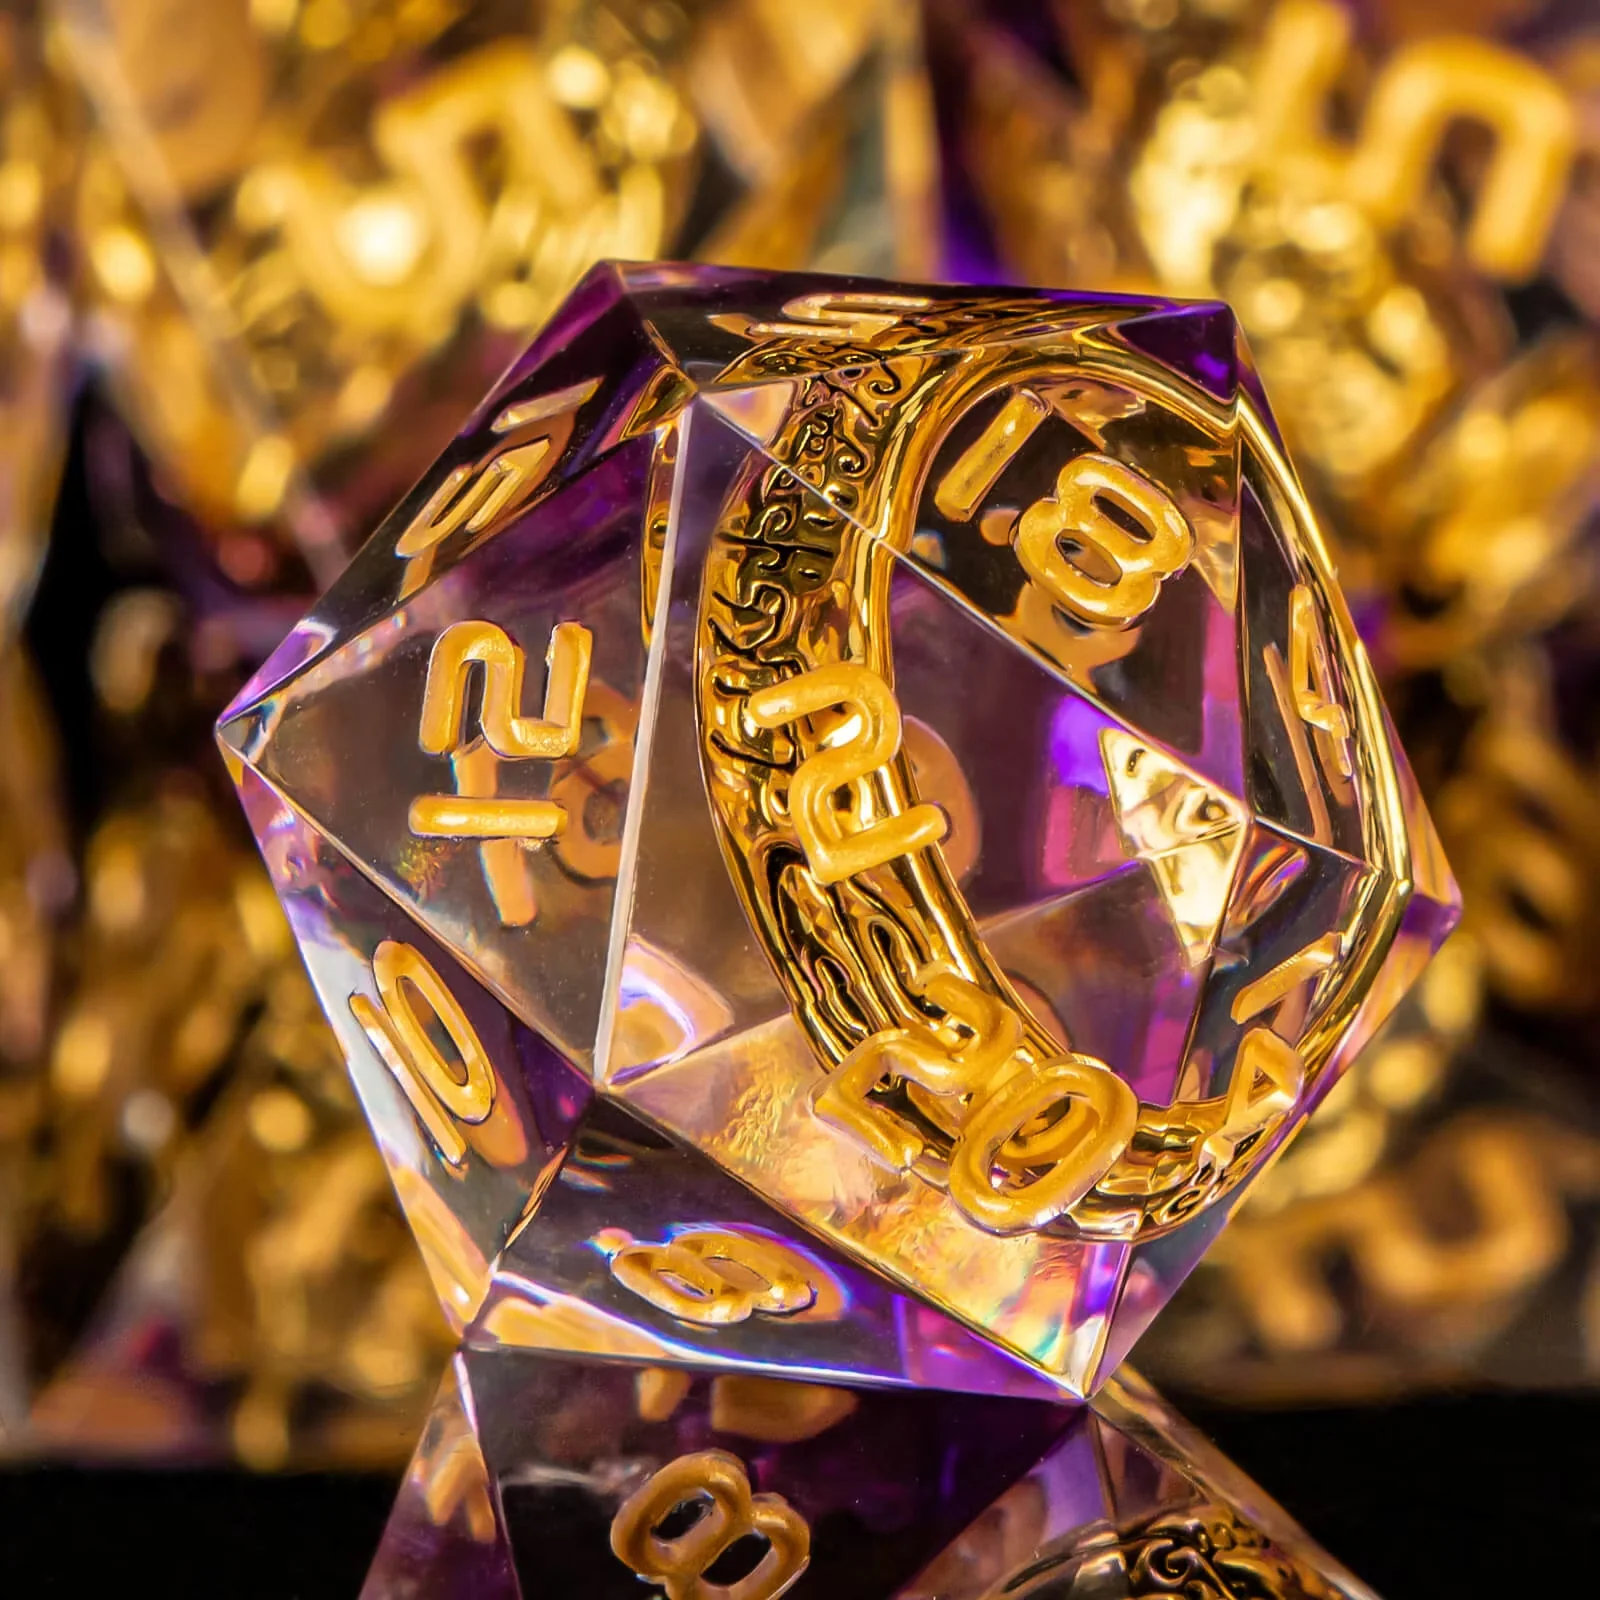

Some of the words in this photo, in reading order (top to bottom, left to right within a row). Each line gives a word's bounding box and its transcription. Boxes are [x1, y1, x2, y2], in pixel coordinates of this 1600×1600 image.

[395, 376, 604, 558] 15
[934, 386, 1194, 626] 18
[408, 620, 594, 841] 12
[749, 662, 948, 884] 2
[348, 940, 496, 1166] 10
[808, 962, 1138, 1237] 20
[1200, 931, 1342, 1172] 14
[610, 1231, 818, 1325] 8
